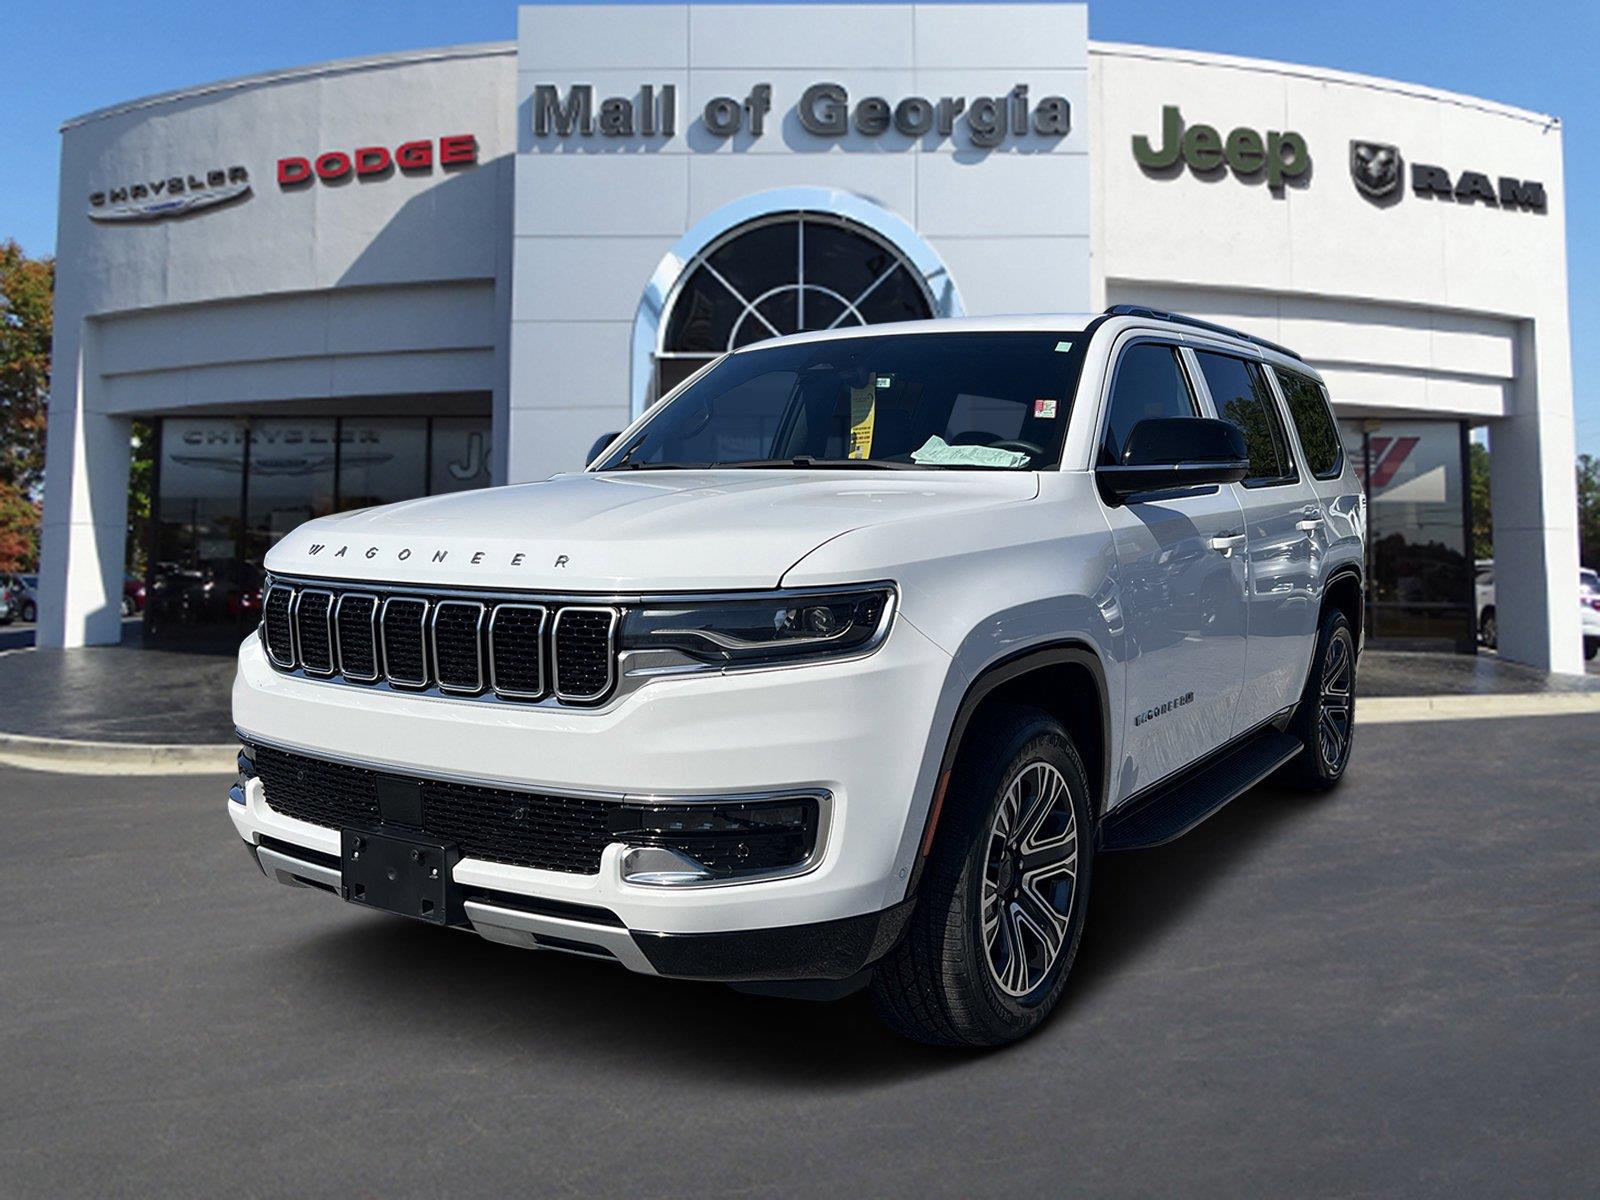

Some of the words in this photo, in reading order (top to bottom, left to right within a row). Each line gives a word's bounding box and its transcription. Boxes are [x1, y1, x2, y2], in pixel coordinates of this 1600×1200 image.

[532, 84, 677, 138] Mall
[703, 83, 772, 137] of
[798, 83, 1072, 149] Georgia
[277, 134, 477, 184] DODGE
[1132, 106, 1309, 194] Jeep
[90, 165, 249, 205] CHRYSLER
[1411, 163, 1548, 212] RAM
[308, 543, 571, 568] WAGONEER
